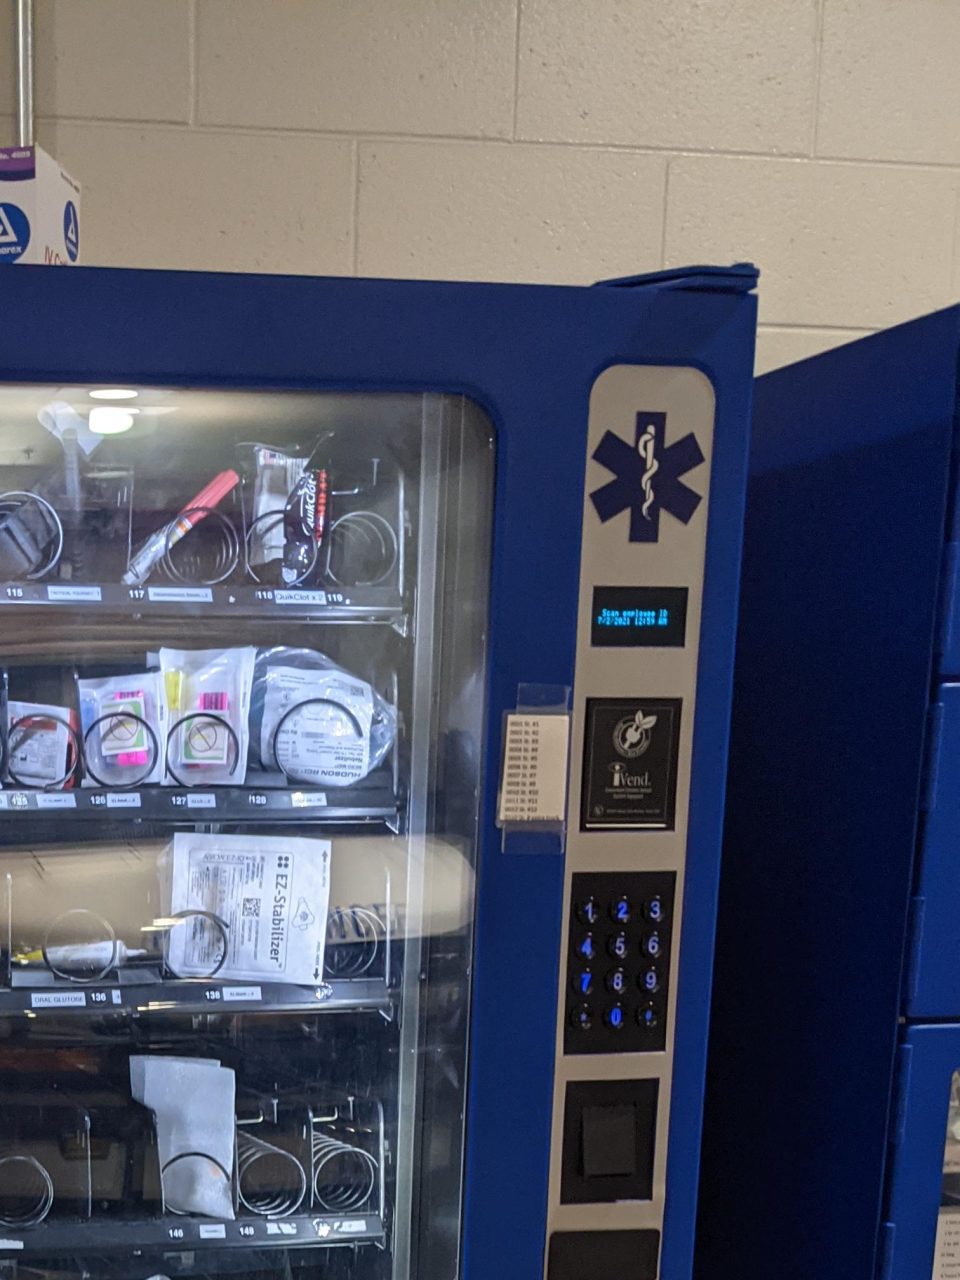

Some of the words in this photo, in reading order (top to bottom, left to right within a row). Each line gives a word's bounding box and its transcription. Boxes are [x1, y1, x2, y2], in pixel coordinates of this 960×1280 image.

[129, 590, 145, 599] 117
[276, 592, 310, 601] QuikClot
[602, 608, 620, 617] Scan
[622, 608, 656, 618] employee
[659, 608, 668, 617] ID
[321, 769, 361, 779] HUDSON
[612, 764, 649, 787] iVend
[171, 796, 187, 806] 127
[585, 902, 592, 920] 1
[617, 901, 628, 919] 2
[650, 901, 661, 919] 3
[581, 938, 592, 955] 4
[615, 938, 625, 956] 5
[648, 936, 659, 954] 6
[581, 972, 591, 993] 7
[613, 972, 623, 990] 8
[645, 971, 656, 989] 9
[610, 1007, 622, 1026] 0
